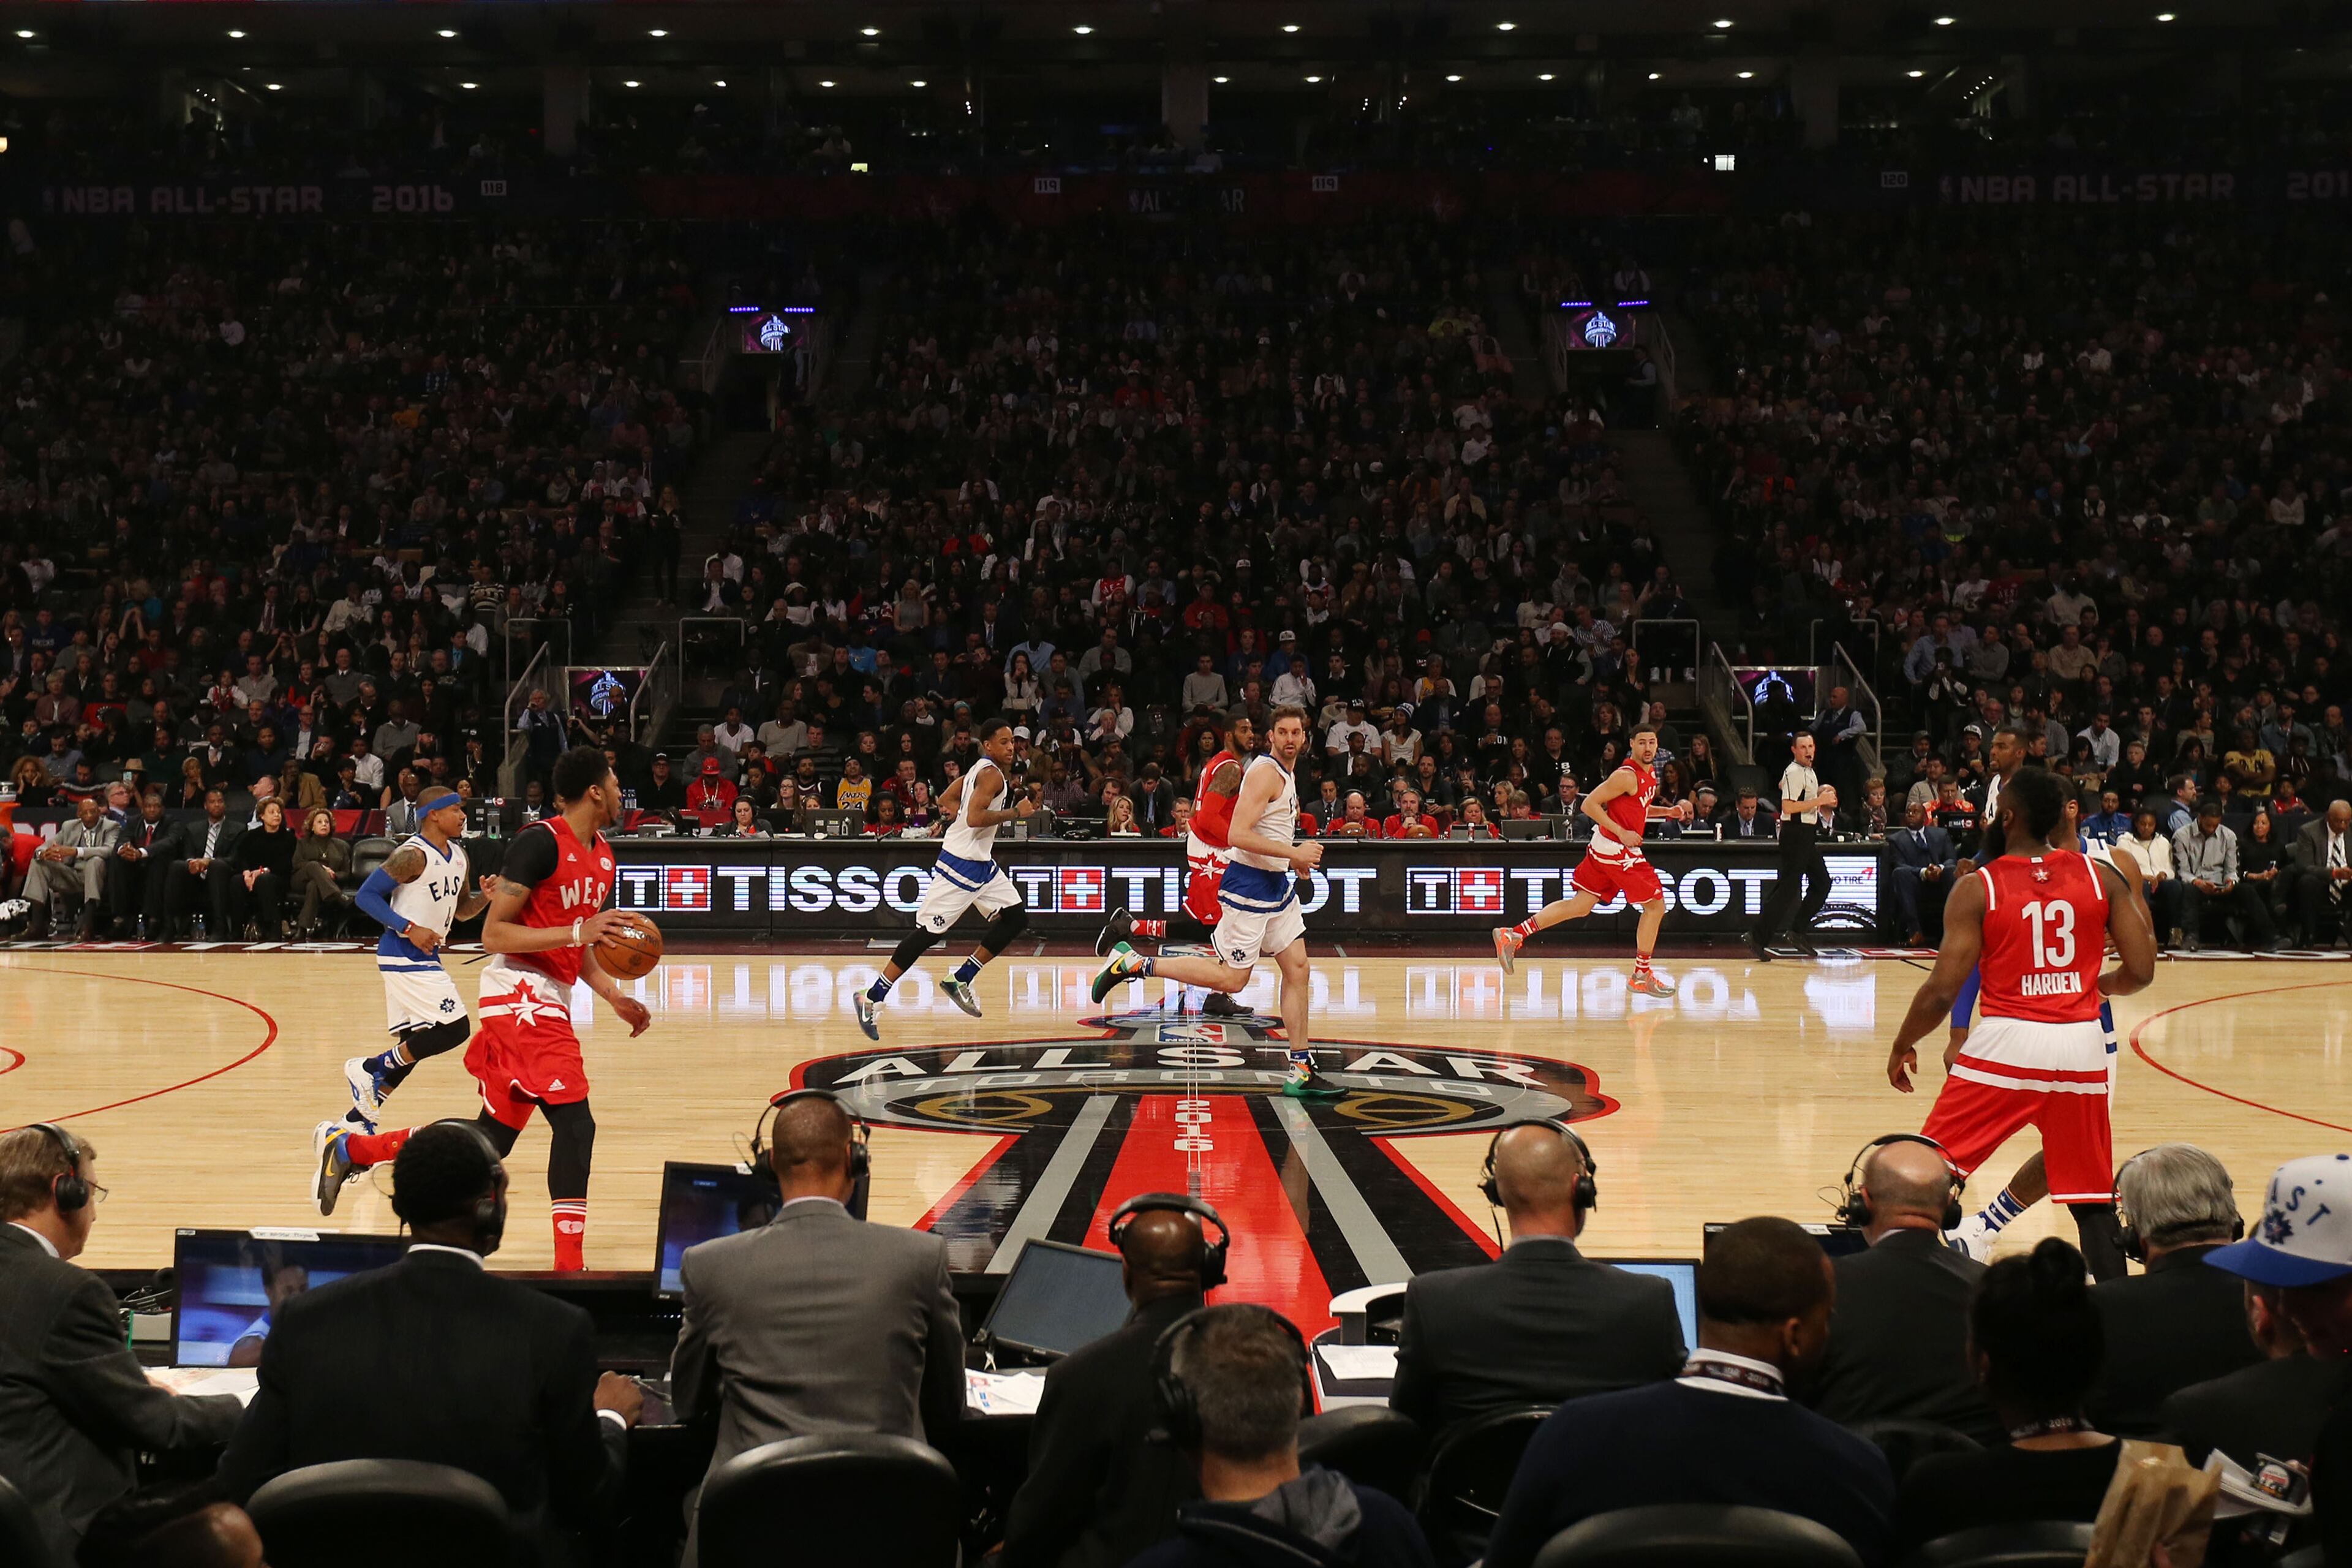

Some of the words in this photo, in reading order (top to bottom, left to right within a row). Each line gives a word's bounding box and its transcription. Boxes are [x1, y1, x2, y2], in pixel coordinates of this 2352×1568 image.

[483, 183, 504, 194] 118
[1037, 180, 1058, 191] 119
[1314, 178, 1336, 189] 119
[1883, 173, 1907, 186] 120
[1961, 175, 2036, 203] NBA
[2053, 173, 2235, 203] ALL-STAR
[2286, 172, 2350, 200] 201
[63, 186, 134, 213] NBA
[151, 186, 323, 213] ALL-STAR
[372, 186, 454, 212] 2016
[839, 791, 868, 801] LAKERS
[842, 801, 863, 810] 24
[429, 876, 460, 902] EAS
[717, 866, 935, 912] TISSO
[1844, 876, 1863, 884] TIRE
[560, 877, 606, 910] WES
[2022, 900, 2075, 968] 13
[2022, 972, 2082, 996] HARDEN
[832, 1048, 1111, 1084] ALL
[1157, 1046, 1548, 1087] STAR
